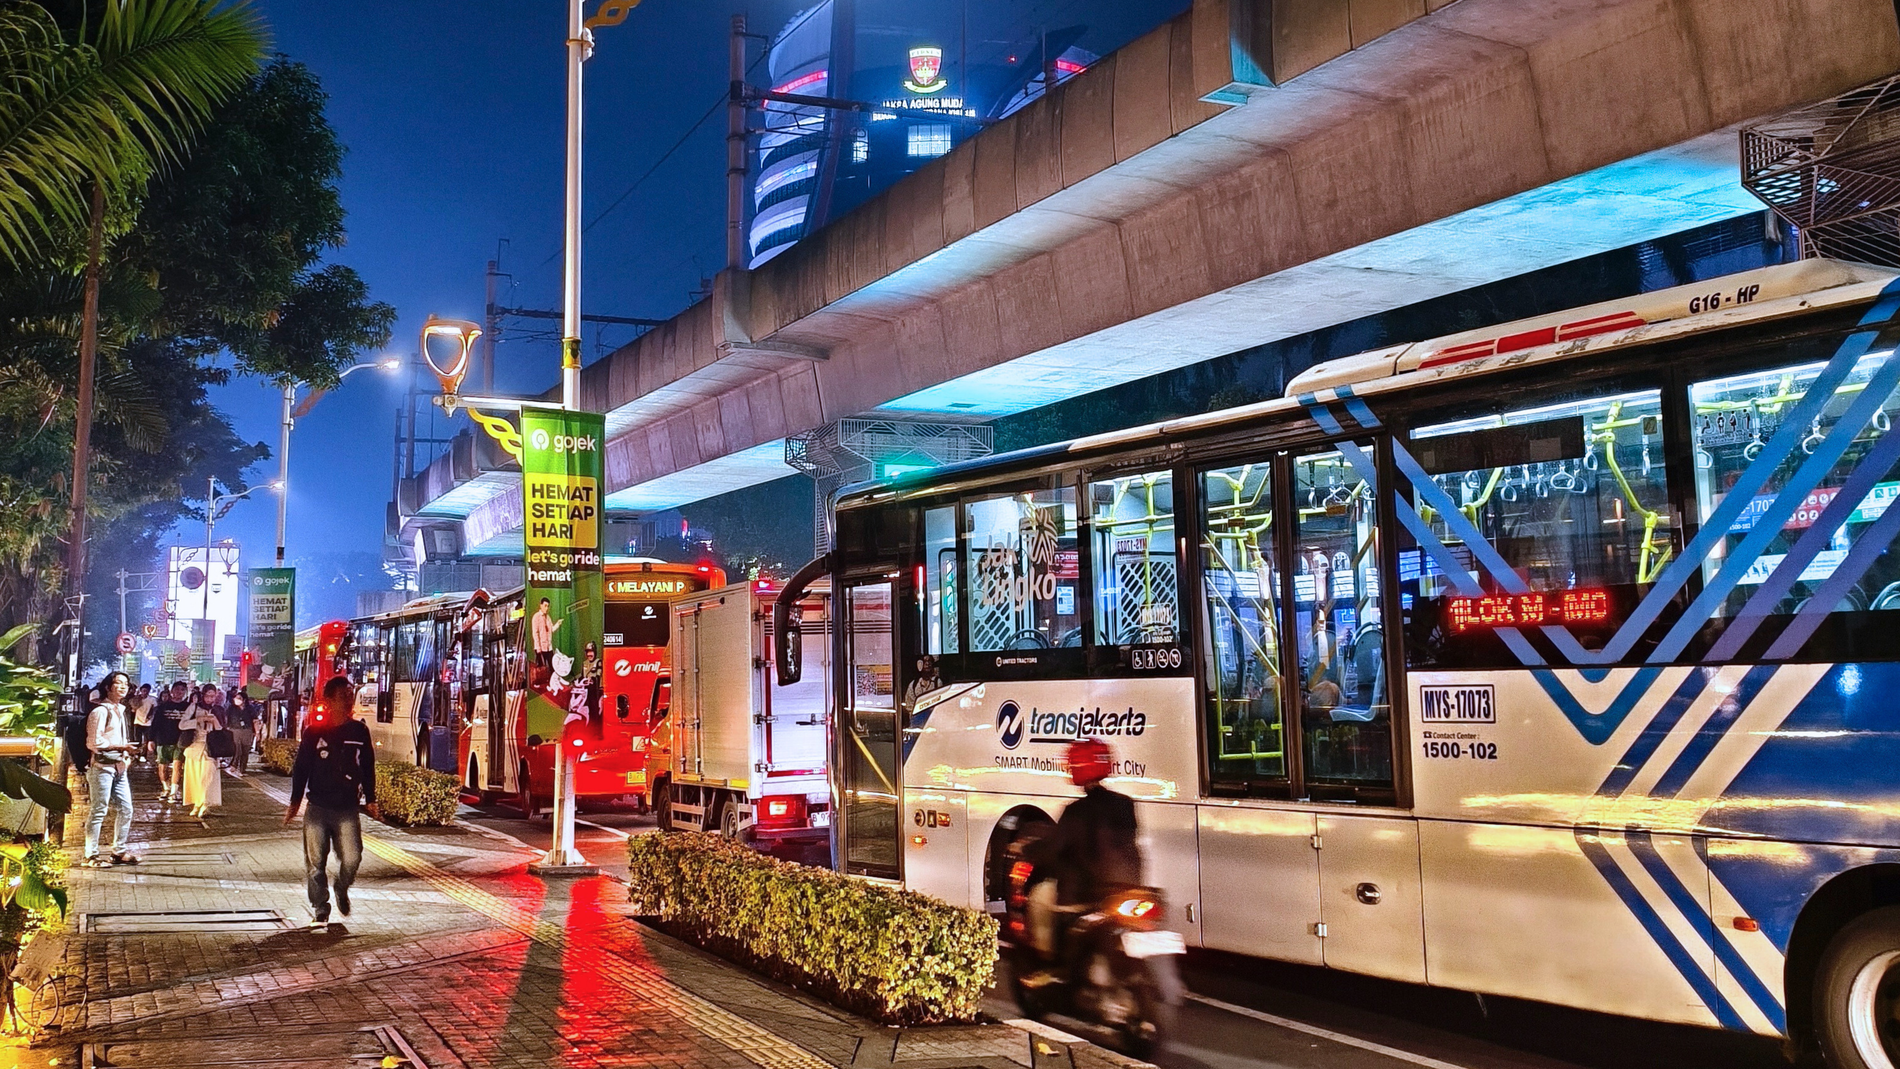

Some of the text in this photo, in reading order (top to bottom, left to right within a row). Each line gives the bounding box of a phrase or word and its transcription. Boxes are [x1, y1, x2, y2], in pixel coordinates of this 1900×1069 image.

[910, 98, 940, 109] AGUNG
[1689, 292, 1721, 314] G16
[1737, 284, 1760, 304] HP
[553, 434, 596, 454] gojek
[531, 484, 593, 502] HEMAT
[532, 503, 594, 520] SETIAP
[532, 523, 573, 539] HARI
[528, 550, 558, 563] let's
[265, 576, 290, 586] gojek
[528, 567, 571, 581] hemat
[617, 582, 673, 593] MELAYANI
[676, 582, 685, 592] P
[983, 565, 1057, 612] Lingko
[253, 605, 288, 613] SETIAP
[1424, 690, 1491, 719] MYS-17073
[1030, 706, 1147, 739] transjakarta
[1433, 732, 1456, 740] Contact
[1423, 742, 1498, 759] 1500-102
[995, 756, 1027, 769] SMART
[1124, 759, 1147, 778] City
